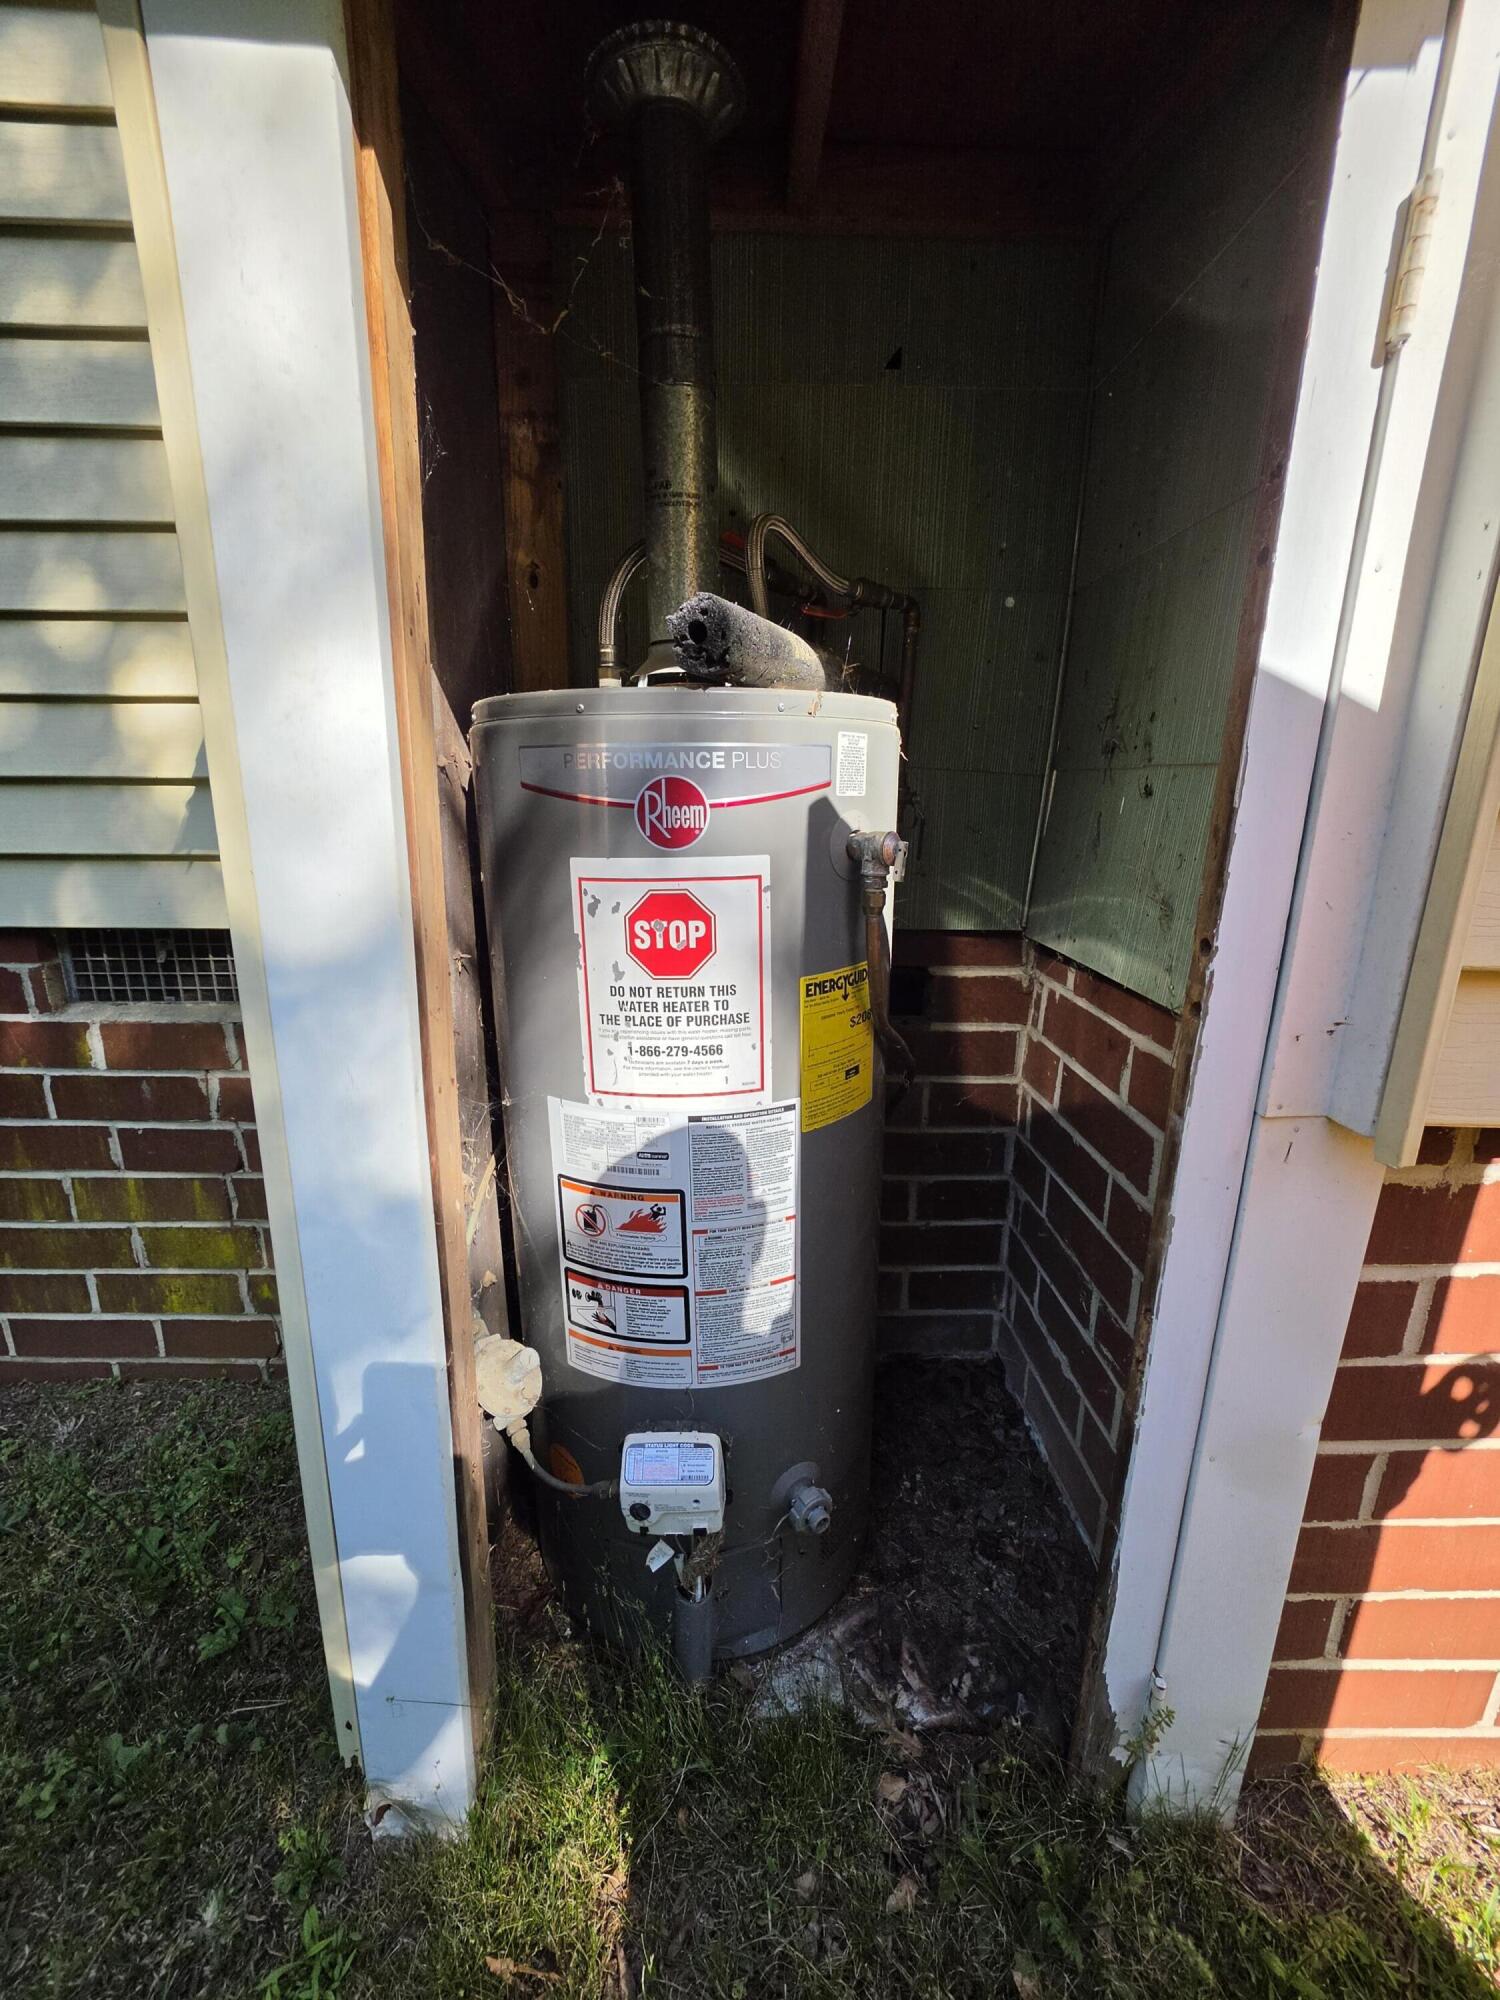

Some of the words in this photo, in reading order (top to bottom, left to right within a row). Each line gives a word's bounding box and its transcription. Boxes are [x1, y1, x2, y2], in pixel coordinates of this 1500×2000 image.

[563, 751, 726, 770] PERFORMANCE
[731, 751, 782, 769] PLUS
[643, 777, 705, 839] Rheem
[633, 919, 707, 951] STOP
[609, 985, 626, 998] DO
[629, 986, 652, 999] NOT
[656, 985, 706, 999] RETURN
[709, 984, 737, 997] THIS
[618, 1000, 659, 1013] WATER
[662, 1000, 710, 1013] HEATER
[714, 999, 730, 1011] TO
[599, 1014, 621, 1026] THE
[666, 1015, 683, 1027] OF
[686, 1012, 751, 1027] PURCHASE
[626, 1044, 724, 1057] 1-866-279-4566
[600, 1189, 645, 1202] WARNING
[605, 1283, 641, 1295] DANGER
